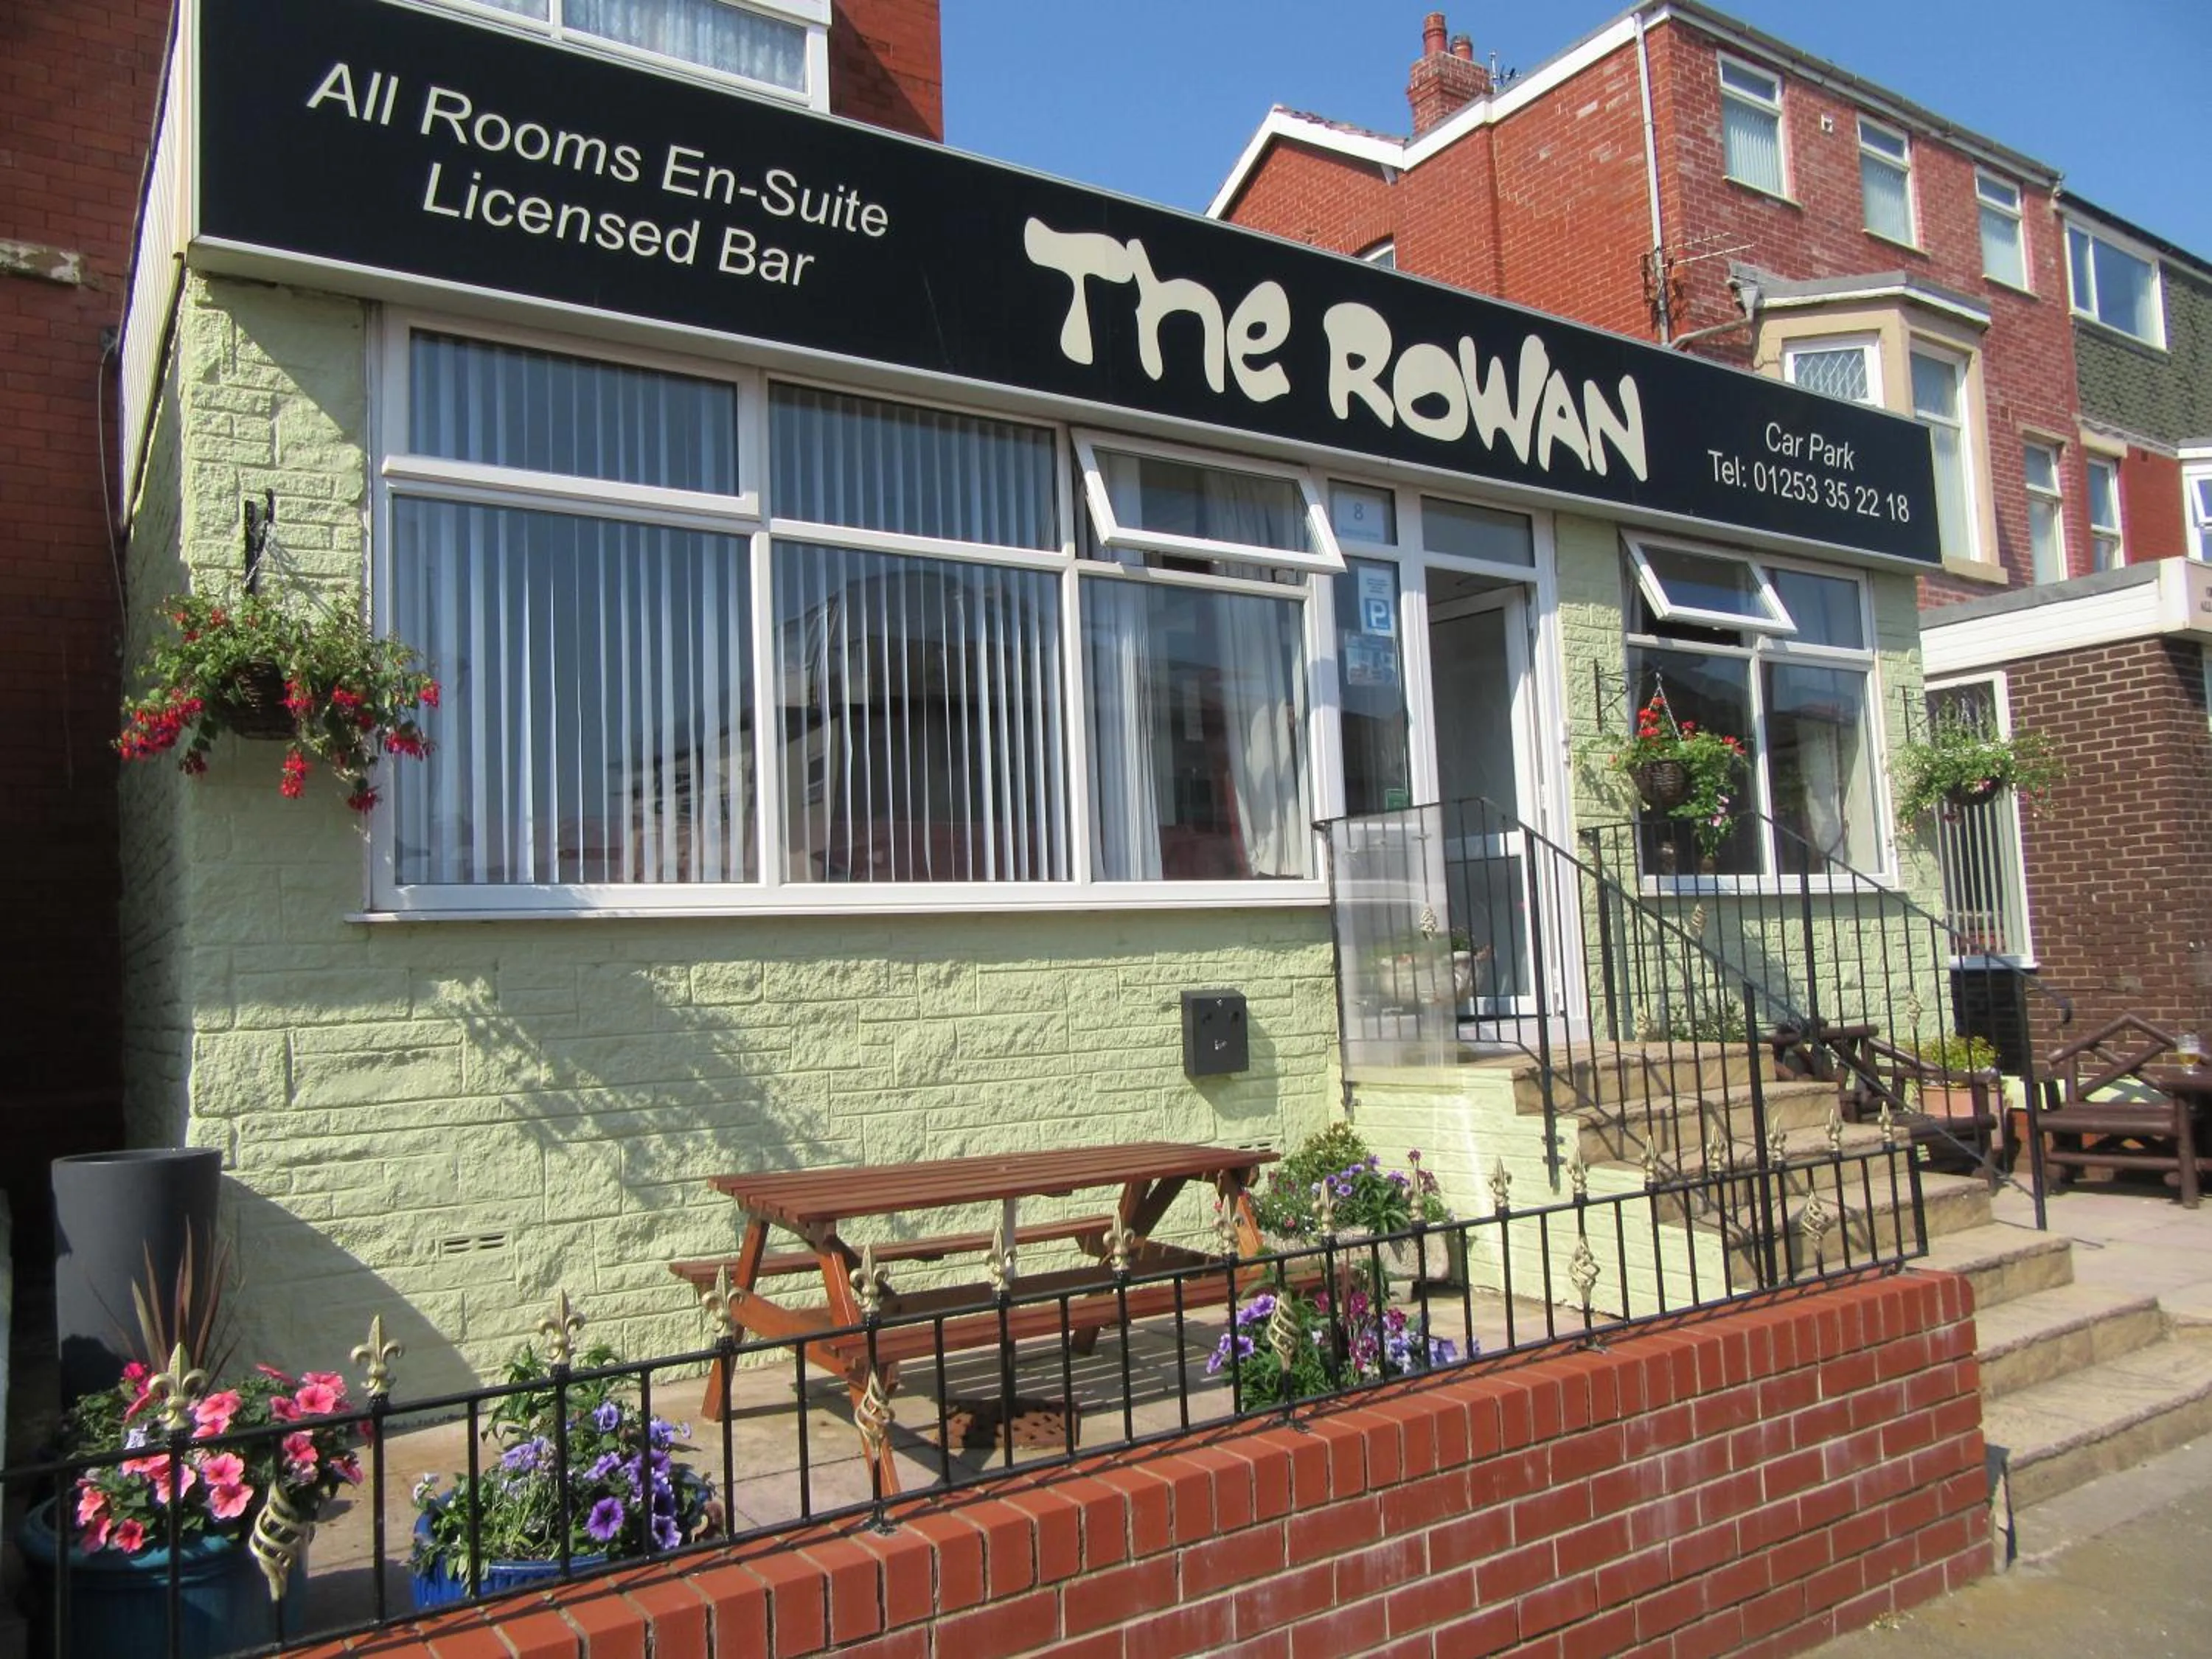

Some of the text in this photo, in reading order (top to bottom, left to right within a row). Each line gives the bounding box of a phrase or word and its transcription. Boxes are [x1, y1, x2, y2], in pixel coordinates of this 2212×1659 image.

[306, 63, 888, 237] All Rooms En-Suite
[422, 162, 815, 286] Licensed Bar
[1023, 217, 1648, 482] The ROWAN
[1766, 422, 1854, 471] Car Park
[1354, 503, 1363, 521] 8
[1707, 449, 1910, 523] Tel: 01253 35 22 18
[1369, 600, 1389, 629] P
